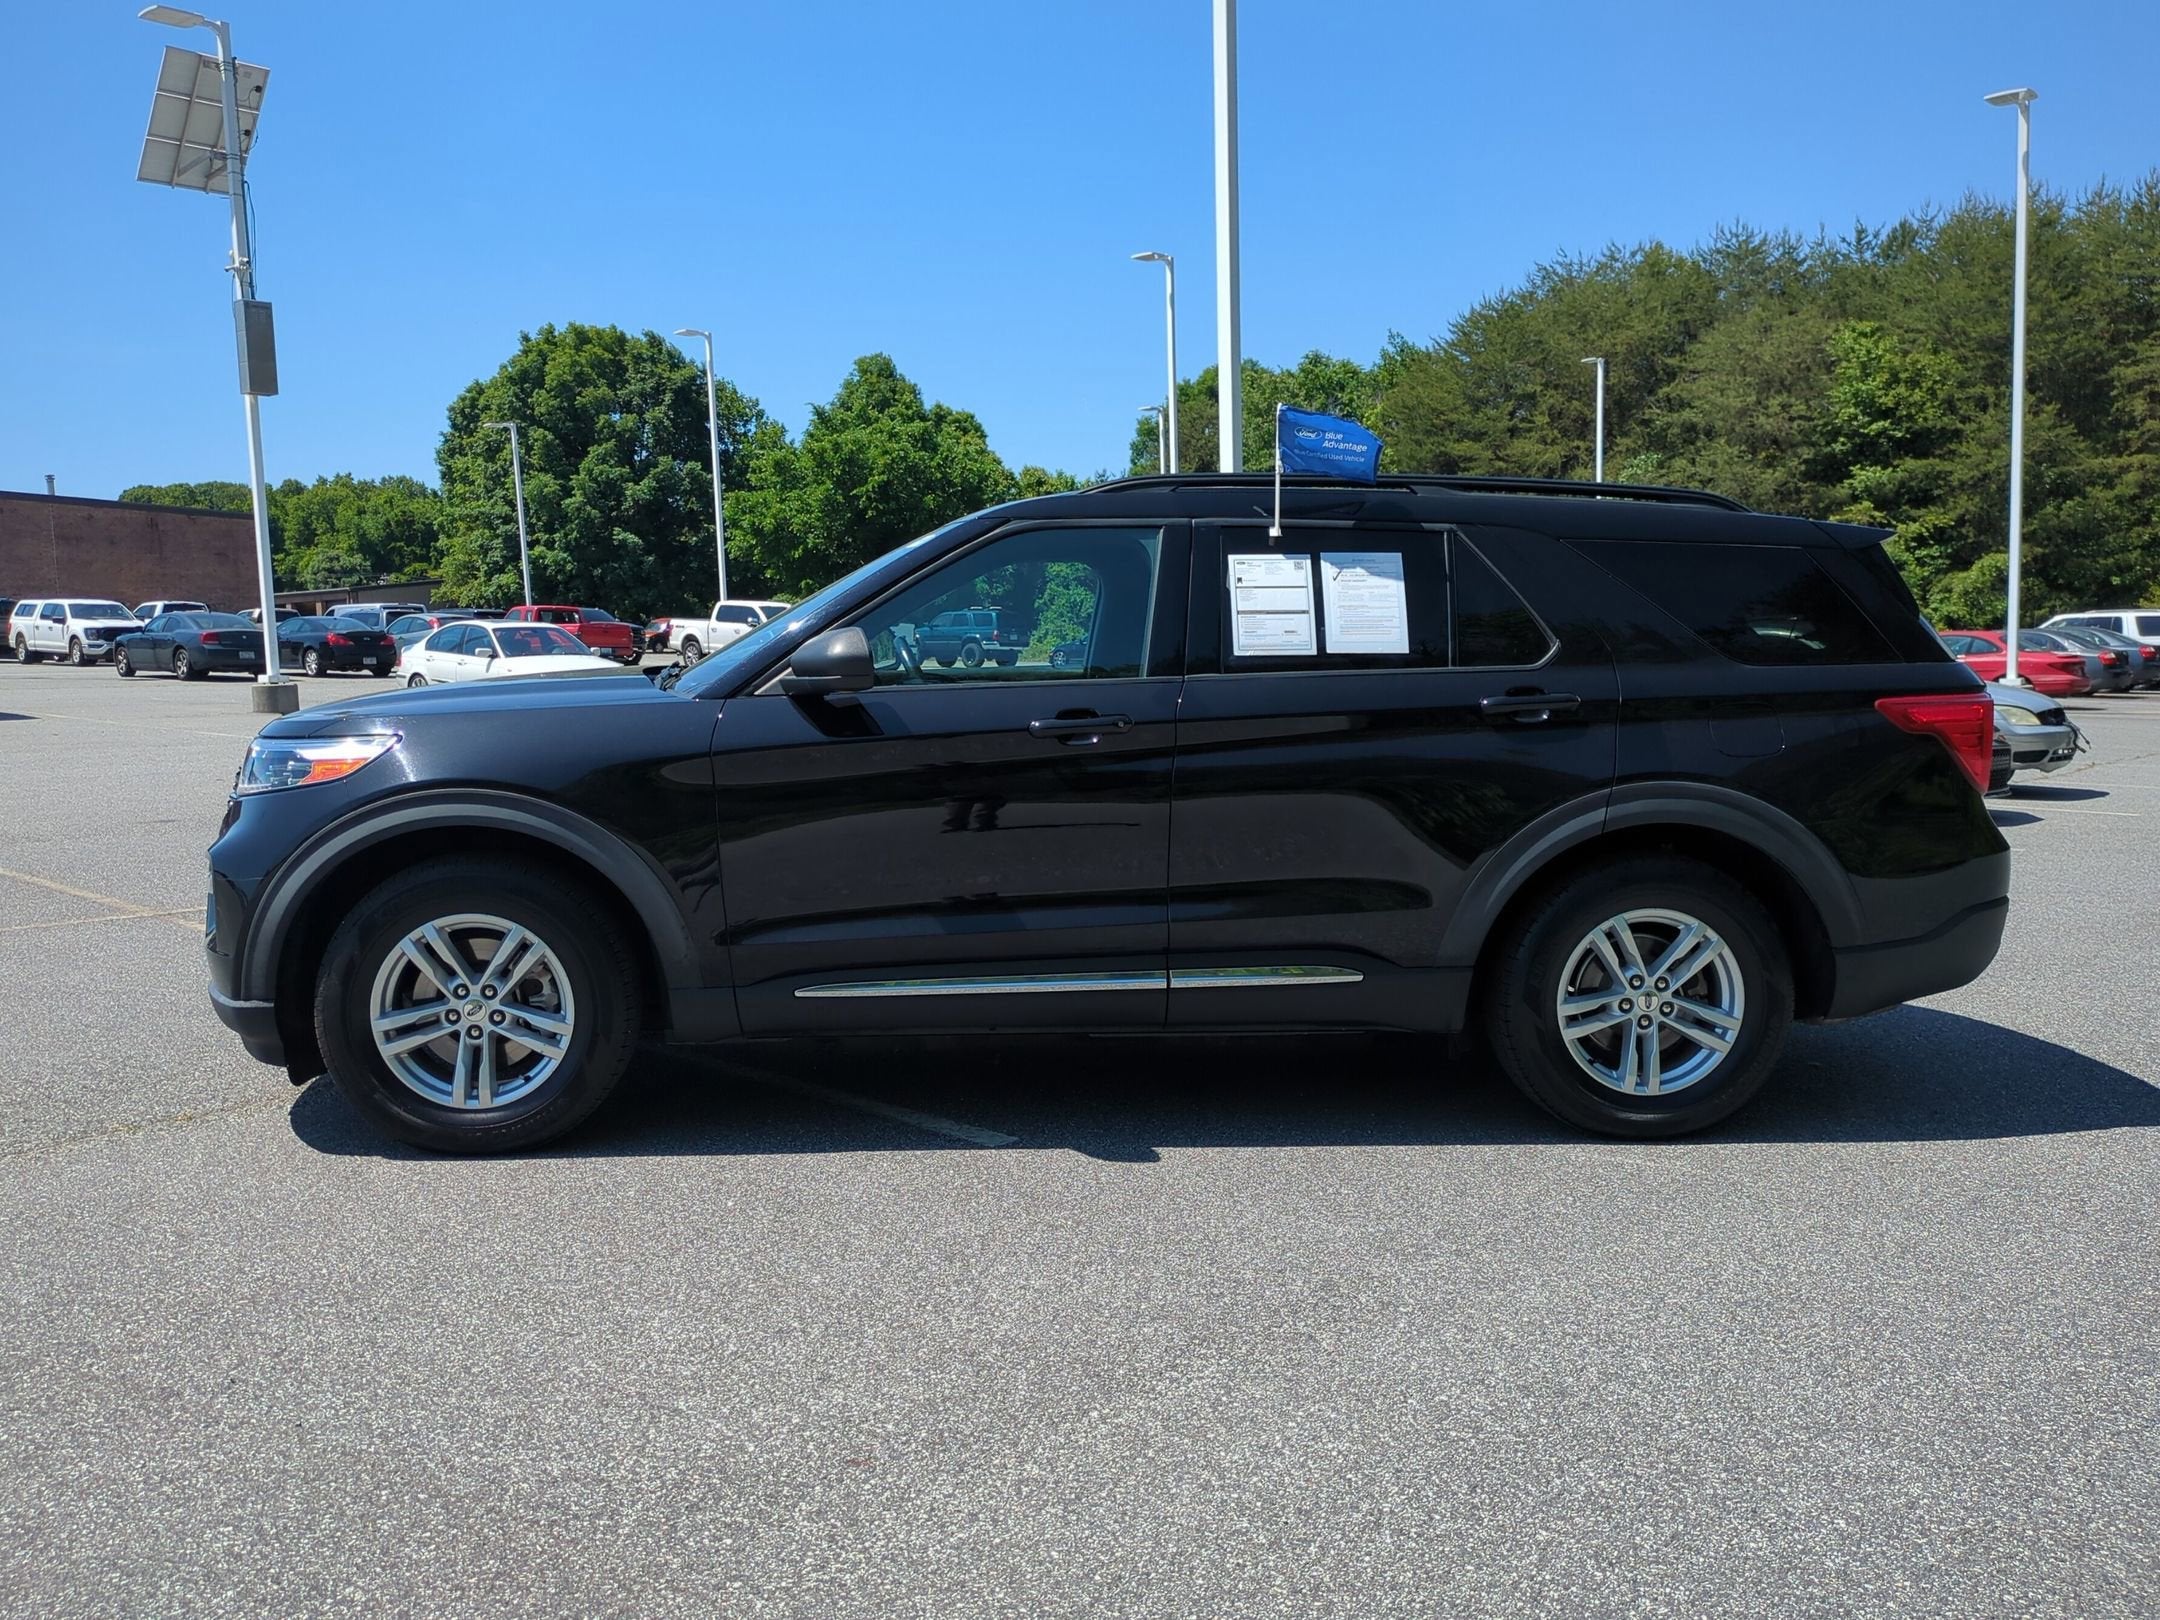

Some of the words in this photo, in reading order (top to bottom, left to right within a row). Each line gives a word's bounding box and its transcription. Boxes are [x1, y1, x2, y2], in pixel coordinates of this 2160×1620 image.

[1325, 432, 1343, 440] Blue
[1322, 440, 1368, 452] Advantage
[1344, 454, 1365, 462] Vehicle
